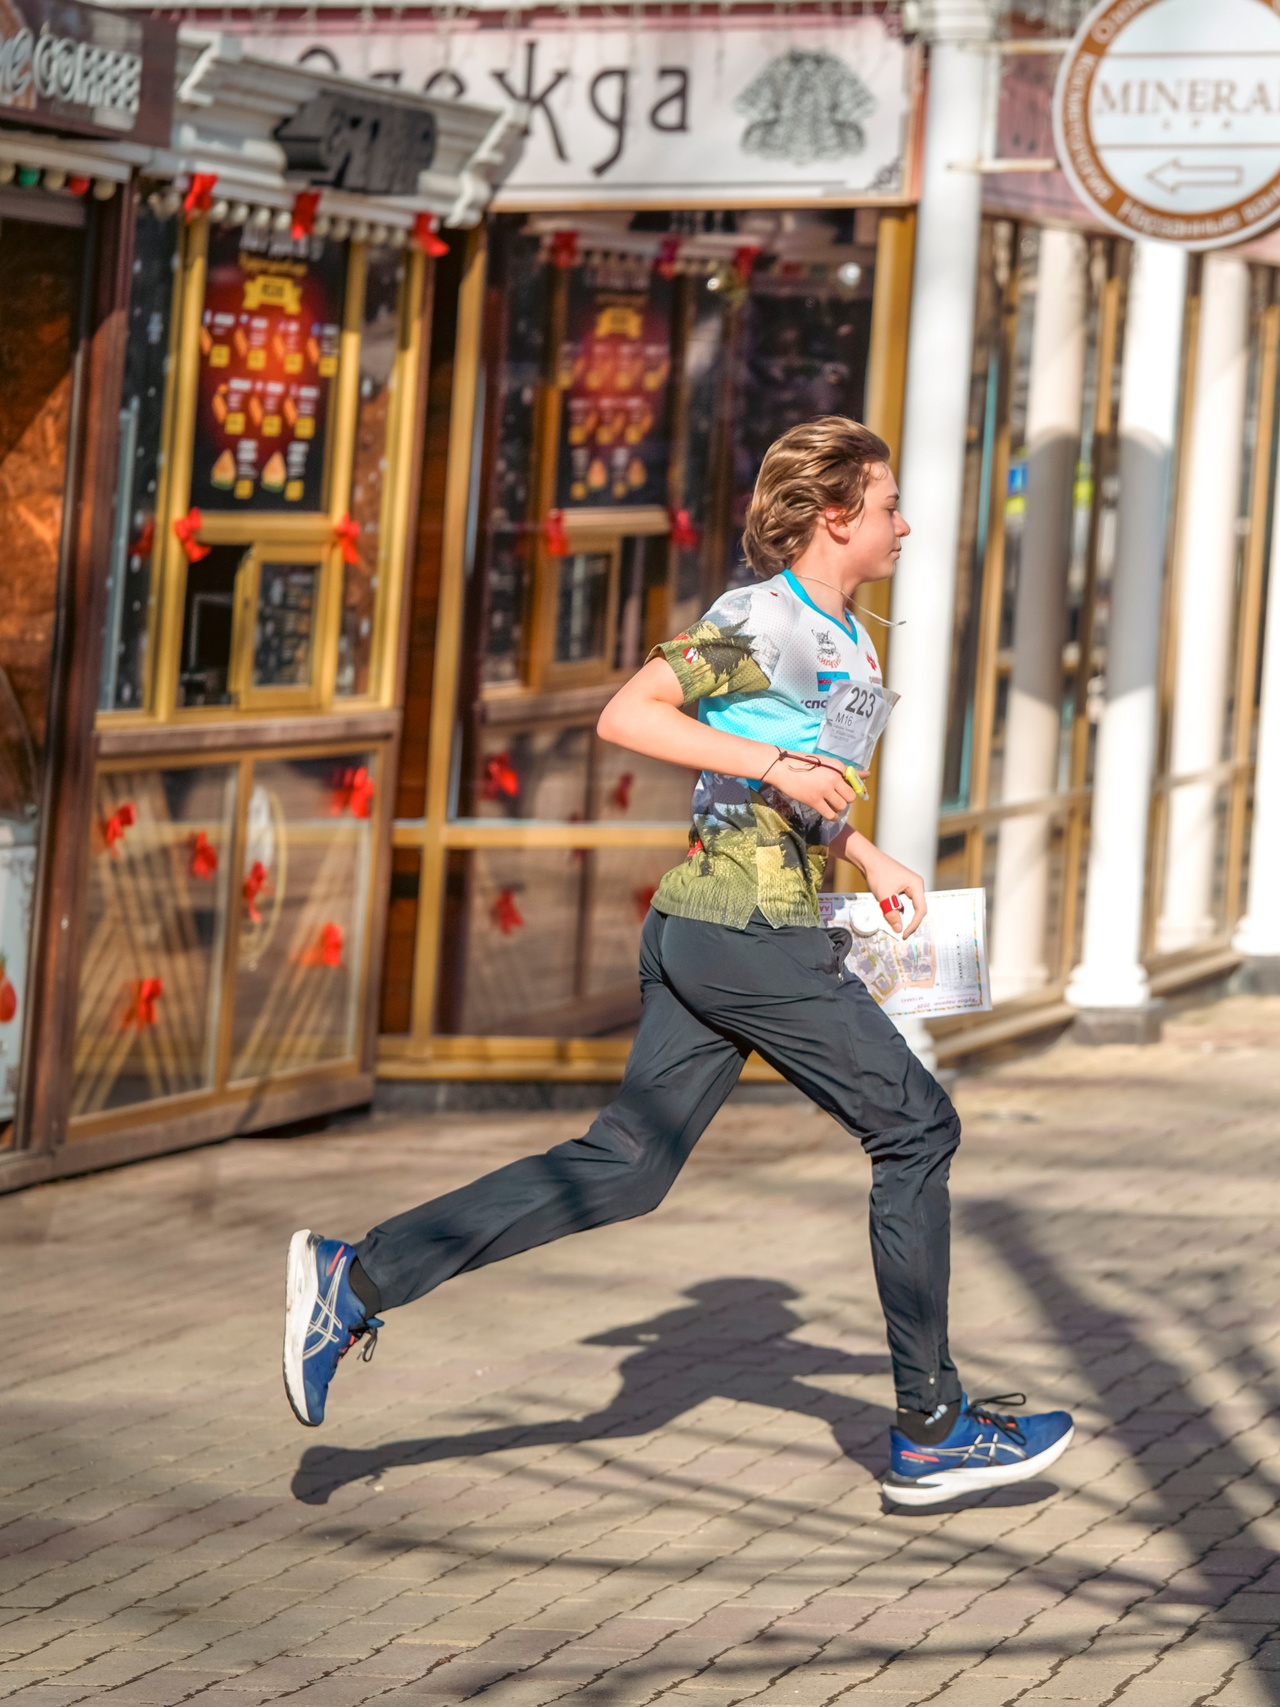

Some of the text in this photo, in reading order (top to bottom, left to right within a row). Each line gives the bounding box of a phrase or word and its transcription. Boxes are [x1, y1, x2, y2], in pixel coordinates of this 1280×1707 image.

[298, 40, 690, 177] жда
[835, 711, 854, 727] M16
[845, 686, 876, 719] 223
